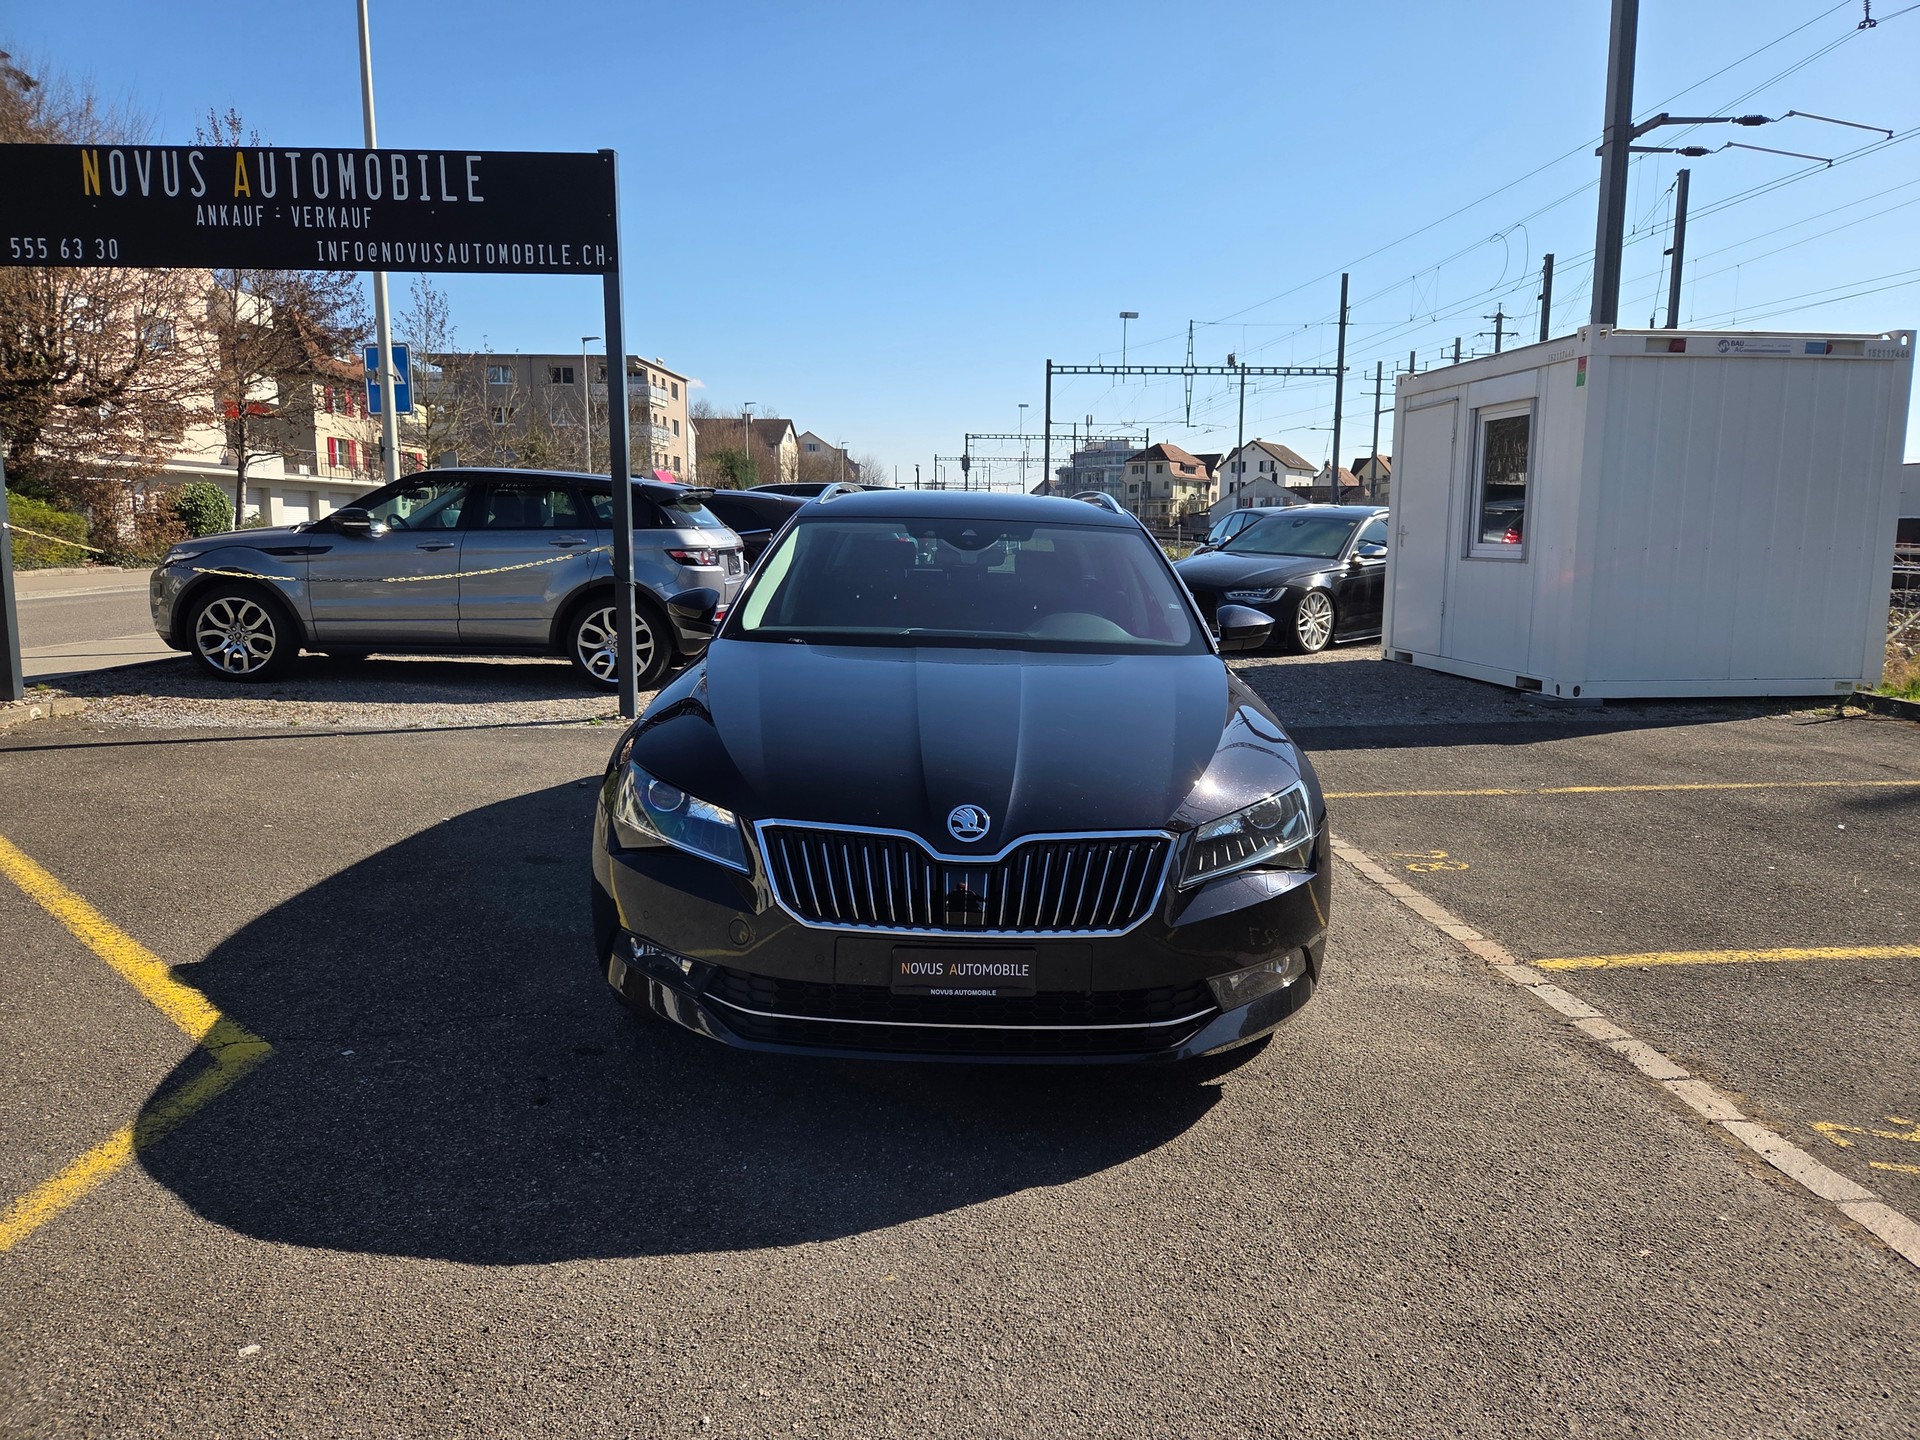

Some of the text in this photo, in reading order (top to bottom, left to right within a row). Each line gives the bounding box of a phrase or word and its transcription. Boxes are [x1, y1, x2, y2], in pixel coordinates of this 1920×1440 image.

[81, 149, 486, 203] NOVUS AUTOMOBILE
[196, 204, 264, 227] ANKAUF
[290, 205, 372, 229] VERKAUF
[10, 237, 118, 260] 555 63 30
[316, 240, 606, 266] INFO@NOVUSAUTOMOBILE.CH
[901, 962, 1030, 977] NOVUS AUTOMOBILE
[930, 988, 997, 997] NOVUS AUTOMOBILE
